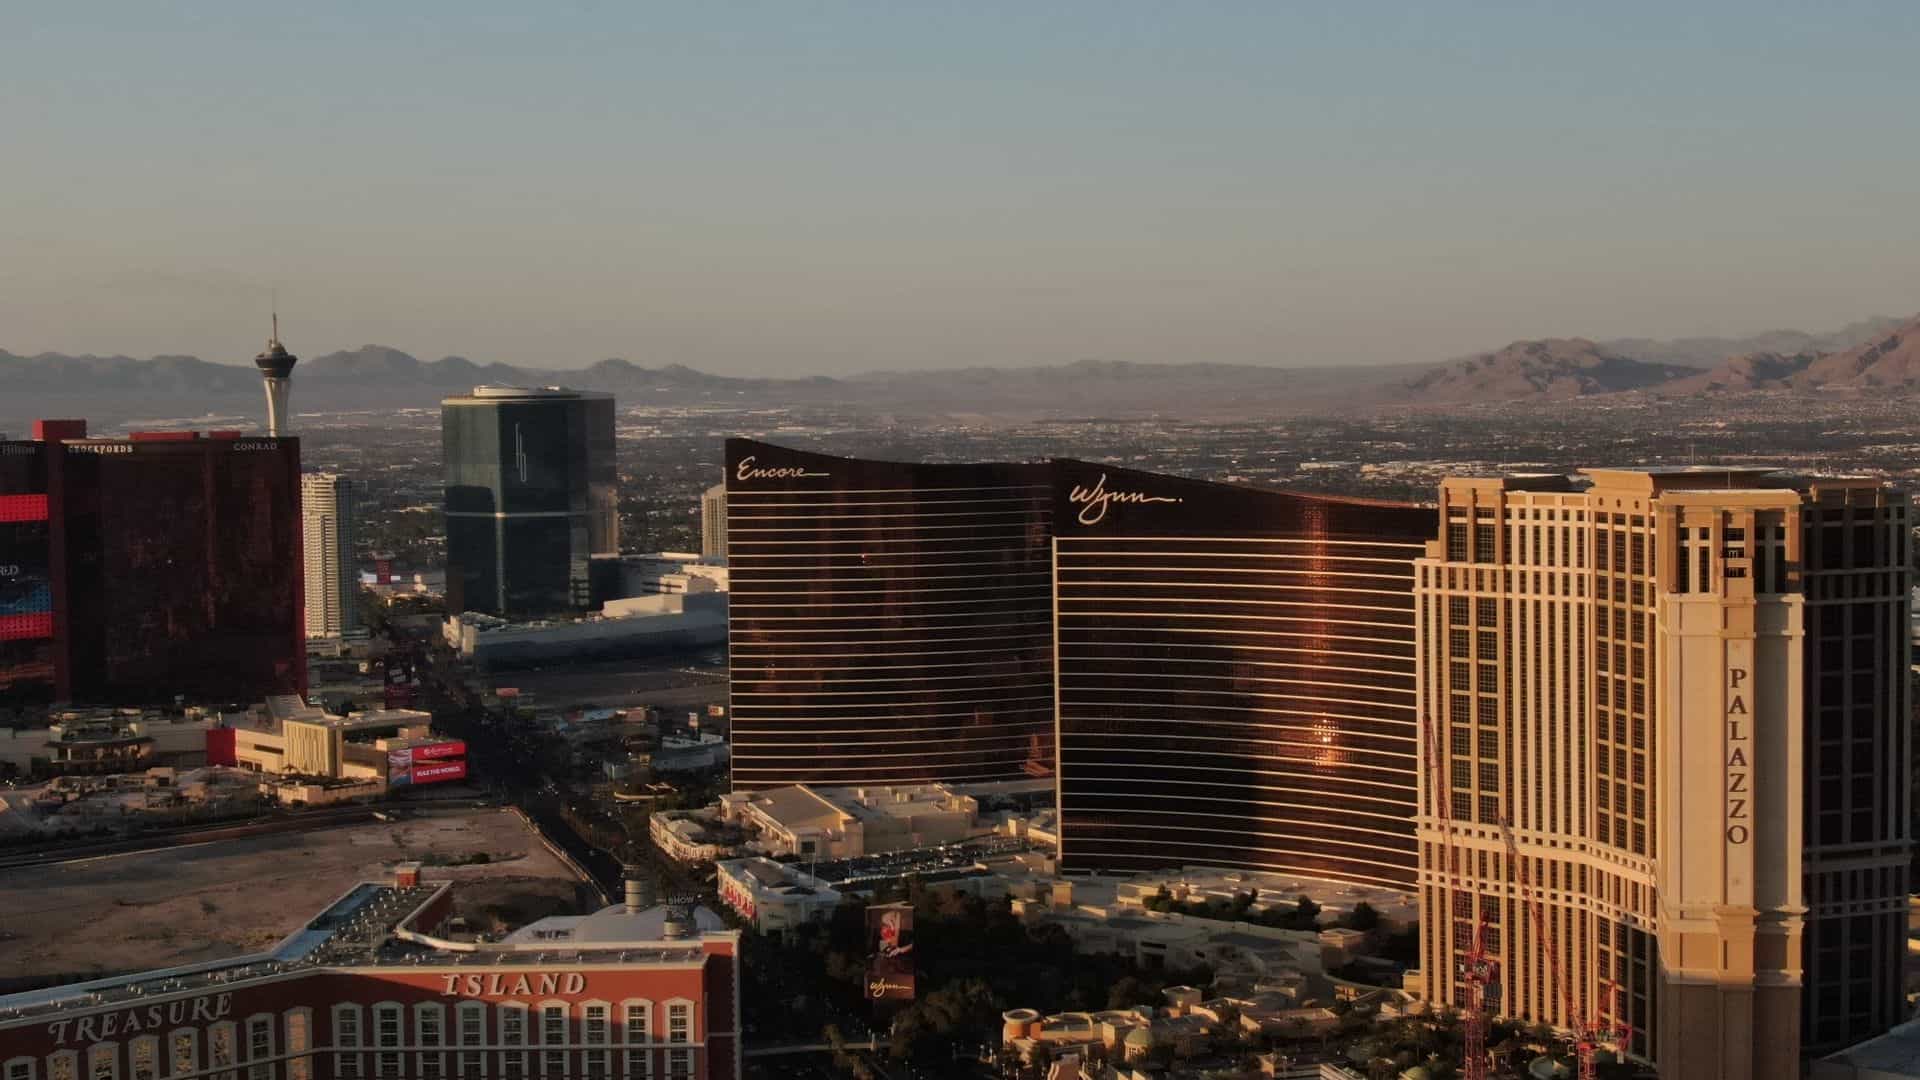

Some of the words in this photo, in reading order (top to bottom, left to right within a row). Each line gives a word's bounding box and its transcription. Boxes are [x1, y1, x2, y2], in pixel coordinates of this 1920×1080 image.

[233, 442, 278, 451] CONRAD
[736, 455, 831, 481] Encore
[1727, 668, 1749, 845] PALAZZO
[440, 973, 587, 997] ISLAND
[48, 992, 233, 1044] TREASURE
